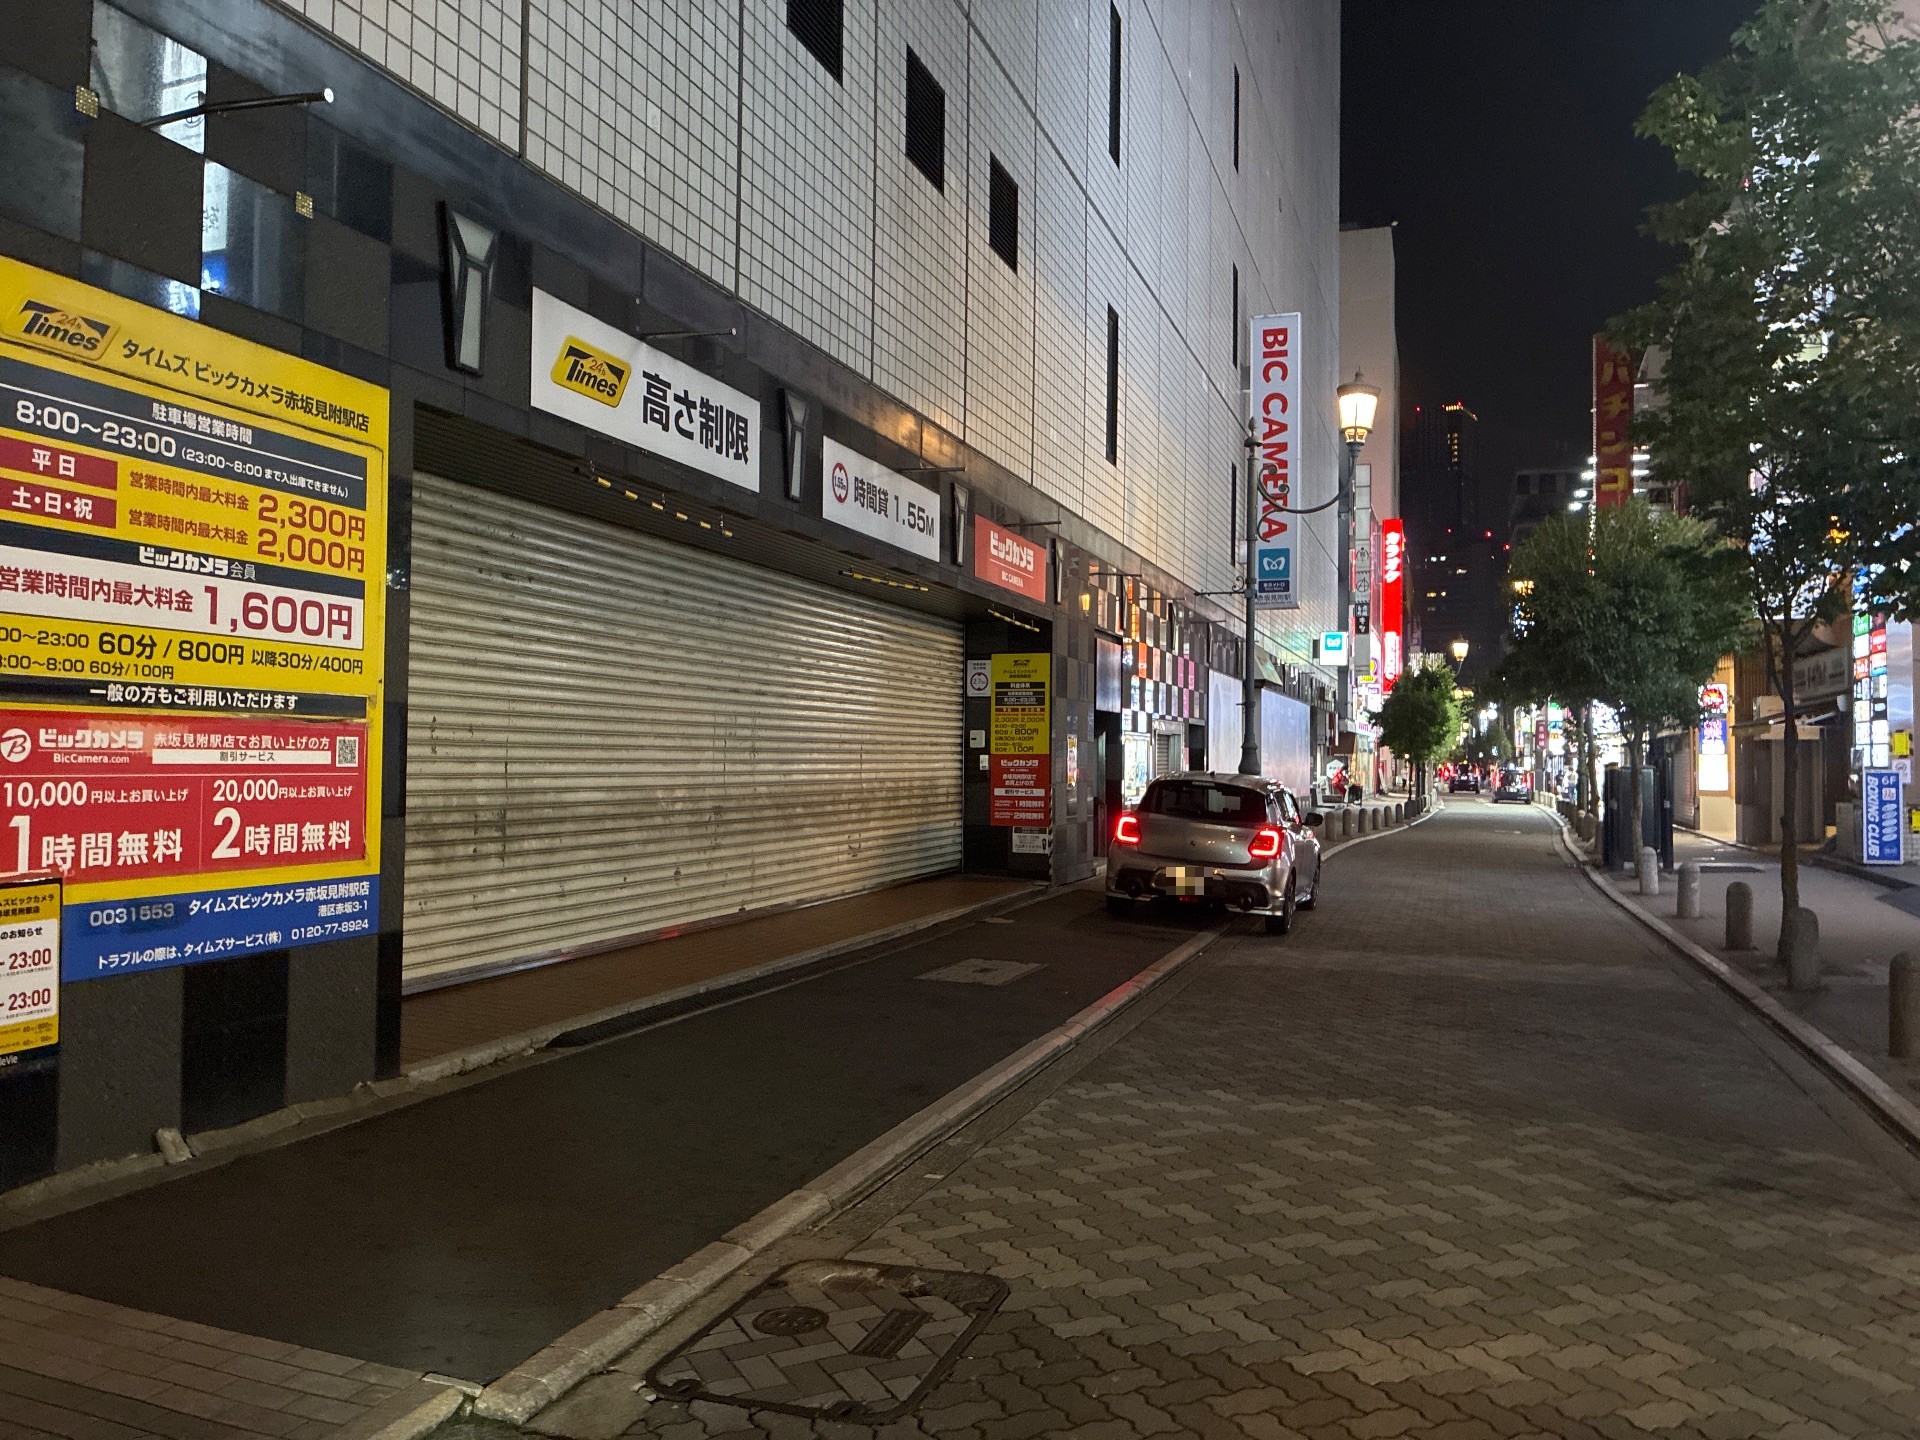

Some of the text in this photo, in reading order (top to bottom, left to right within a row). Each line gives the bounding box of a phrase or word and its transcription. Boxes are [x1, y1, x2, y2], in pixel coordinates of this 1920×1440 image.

[18, 299, 106, 350] Times
[122, 338, 370, 434] タイムズ ビックカメラ赤坂見附駅店
[563, 345, 622, 398] Times
[151, 401, 253, 445] 駐車場営業時間
[642, 370, 749, 466] 高さ制限
[1262, 327, 1289, 543] BIC CAMERA
[31, 449, 77, 477] 平日
[11, 486, 93, 521] 土・日・祝
[129, 471, 366, 540] 営業時間内最大料金 2,300円
[854, 476, 935, 538] 時間貸 1.55M
[128, 508, 365, 574] 営業時間内最大料金 2,000円
[990, 530, 1034, 572] ビックカメラ
[139, 545, 257, 582] ビックカメラ会員
[0, 565, 353, 641] 営業時間内最大料金 1,600円
[89, 662, 174, 680] 60分/100円
[98, 631, 158, 661] 60分
[177, 641, 245, 667] 800円
[251, 649, 364, 675] 以降30分/400円
[89, 681, 299, 711] 一般の方もご利用いただけます
[38, 728, 331, 750] ビックカメラ 赤坂見附駅店でお買い上げの方
[53, 753, 130, 764] BicCamera.com
[219, 751, 275, 762] 割引サービス
[1867, 775, 1879, 823] BOXING
[1881, 775, 1897, 786] 6F
[8, 814, 184, 873] 1時間無料
[211, 806, 352, 860] 2時間無料
[1867, 823, 1880, 858] CLUB
[188, 881, 370, 916] タイムズビックカメラ赤坂見附駅店
[317, 900, 368, 918] 港区赤坂3-1
[291, 918, 369, 940] 0120-77-8924
